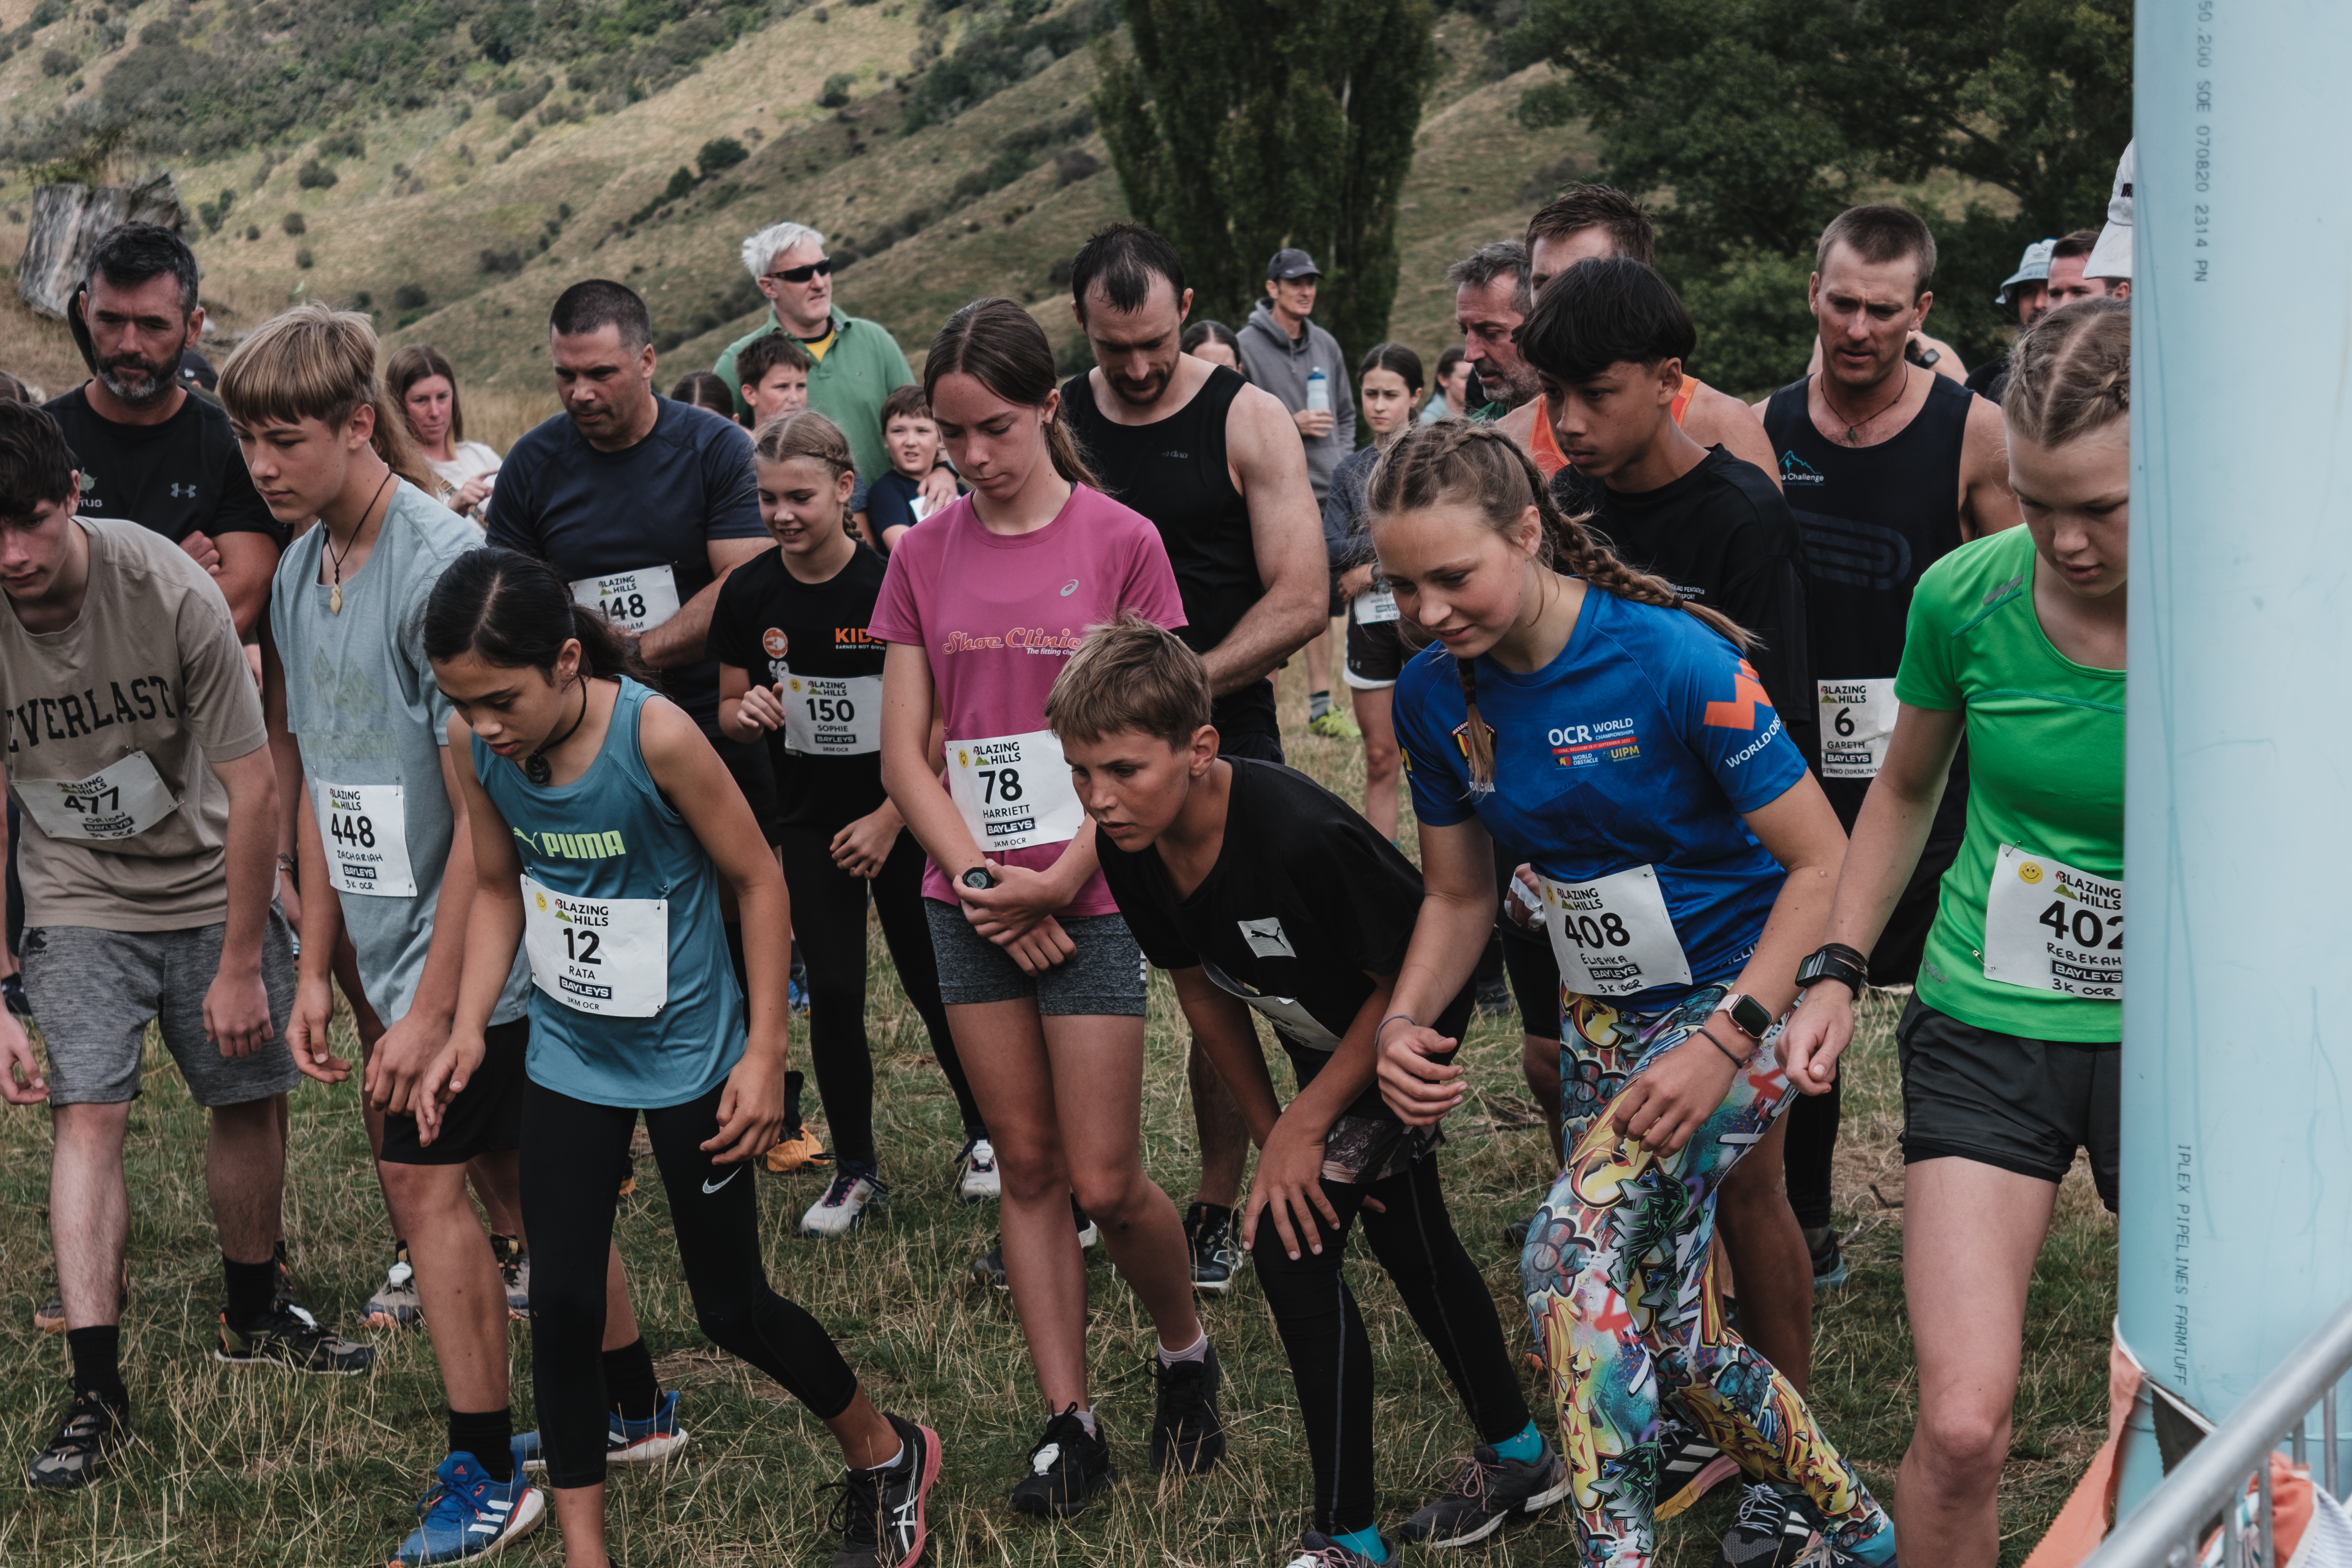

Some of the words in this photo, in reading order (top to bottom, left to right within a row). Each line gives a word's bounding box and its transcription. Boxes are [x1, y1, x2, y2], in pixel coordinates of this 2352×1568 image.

[2195, 126, 2210, 193] 070820
[2194, 204, 2210, 248] 2314
[2194, 259, 2209, 282] PN
[1788, 473, 1824, 482] Challenge
[598, 575, 635, 587] BLAZING
[613, 583, 637, 593] HILLS
[599, 593, 646, 621] 148
[835, 628, 884, 644] KID
[942, 631, 1004, 655] Shoe
[1006, 627, 1082, 650] Clinic
[1040, 648, 1061, 656] fitting
[808, 681, 846, 689] BLAZING
[1821, 685, 1866, 694] BLAZING
[1838, 695, 1866, 703] HILLS
[6, 676, 175, 753] EVERLAST
[806, 698, 855, 722] 150
[1834, 707, 1855, 737] 6
[1548, 725, 1592, 746] OCR
[1592, 718, 1633, 733] WORLD
[1596, 729, 1634, 740] CHAMPIONSHIPS
[973, 741, 1020, 755] BLAZING
[1611, 745, 1639, 759] UIPM
[1726, 732, 1771, 768] WORLD
[1827, 741, 1865, 749] GARETH
[991, 752, 1021, 765] HILLS
[1573, 758, 1598, 766] OBSTACLE
[57, 776, 104, 790] BLAZING
[78, 783, 107, 796] HILLS
[978, 768, 1023, 805] 78
[64, 786, 119, 814] 477
[330, 788, 360, 800] BLAZING
[341, 801, 361, 811] HILLS
[983, 804, 1030, 818] HARRIETT
[85, 812, 125, 823] ORION
[86, 819, 131, 831] BAYLEYS
[331, 813, 375, 848] 448
[987, 820, 1032, 834] BAYLEYS
[541, 830, 626, 859] PUMA
[1010, 837, 1026, 845] OCR
[337, 850, 383, 862] ZACHARIAH
[345, 866, 374, 878] BAYLEYS
[359, 881, 374, 890] OCR
[2056, 871, 2121, 899] BLAZING
[1557, 888, 1599, 900] BLAZING
[2079, 892, 2121, 910] HILLS
[555, 898, 609, 916] BLAZING
[1573, 898, 1603, 911] HILLS
[574, 914, 609, 927] HILLS
[1565, 912, 1630, 949] 408
[563, 928, 602, 965] 12
[2047, 942, 2121, 966] REBEKAH
[569, 965, 596, 980] RATA
[1593, 966, 1637, 979] BAYLEYS
[2055, 964, 2122, 981] BAYLEYS
[561, 978, 609, 997] BAYLEYS
[2082, 987, 2116, 997] OCR
[567, 996, 581, 1007] 3KM
[583, 1002, 600, 1011] OCR
[2177, 1144, 2192, 1194] IPLEX
[2175, 1204, 2190, 1295] PIPELINES
[2174, 1305, 2188, 1386] FARMTUFF
